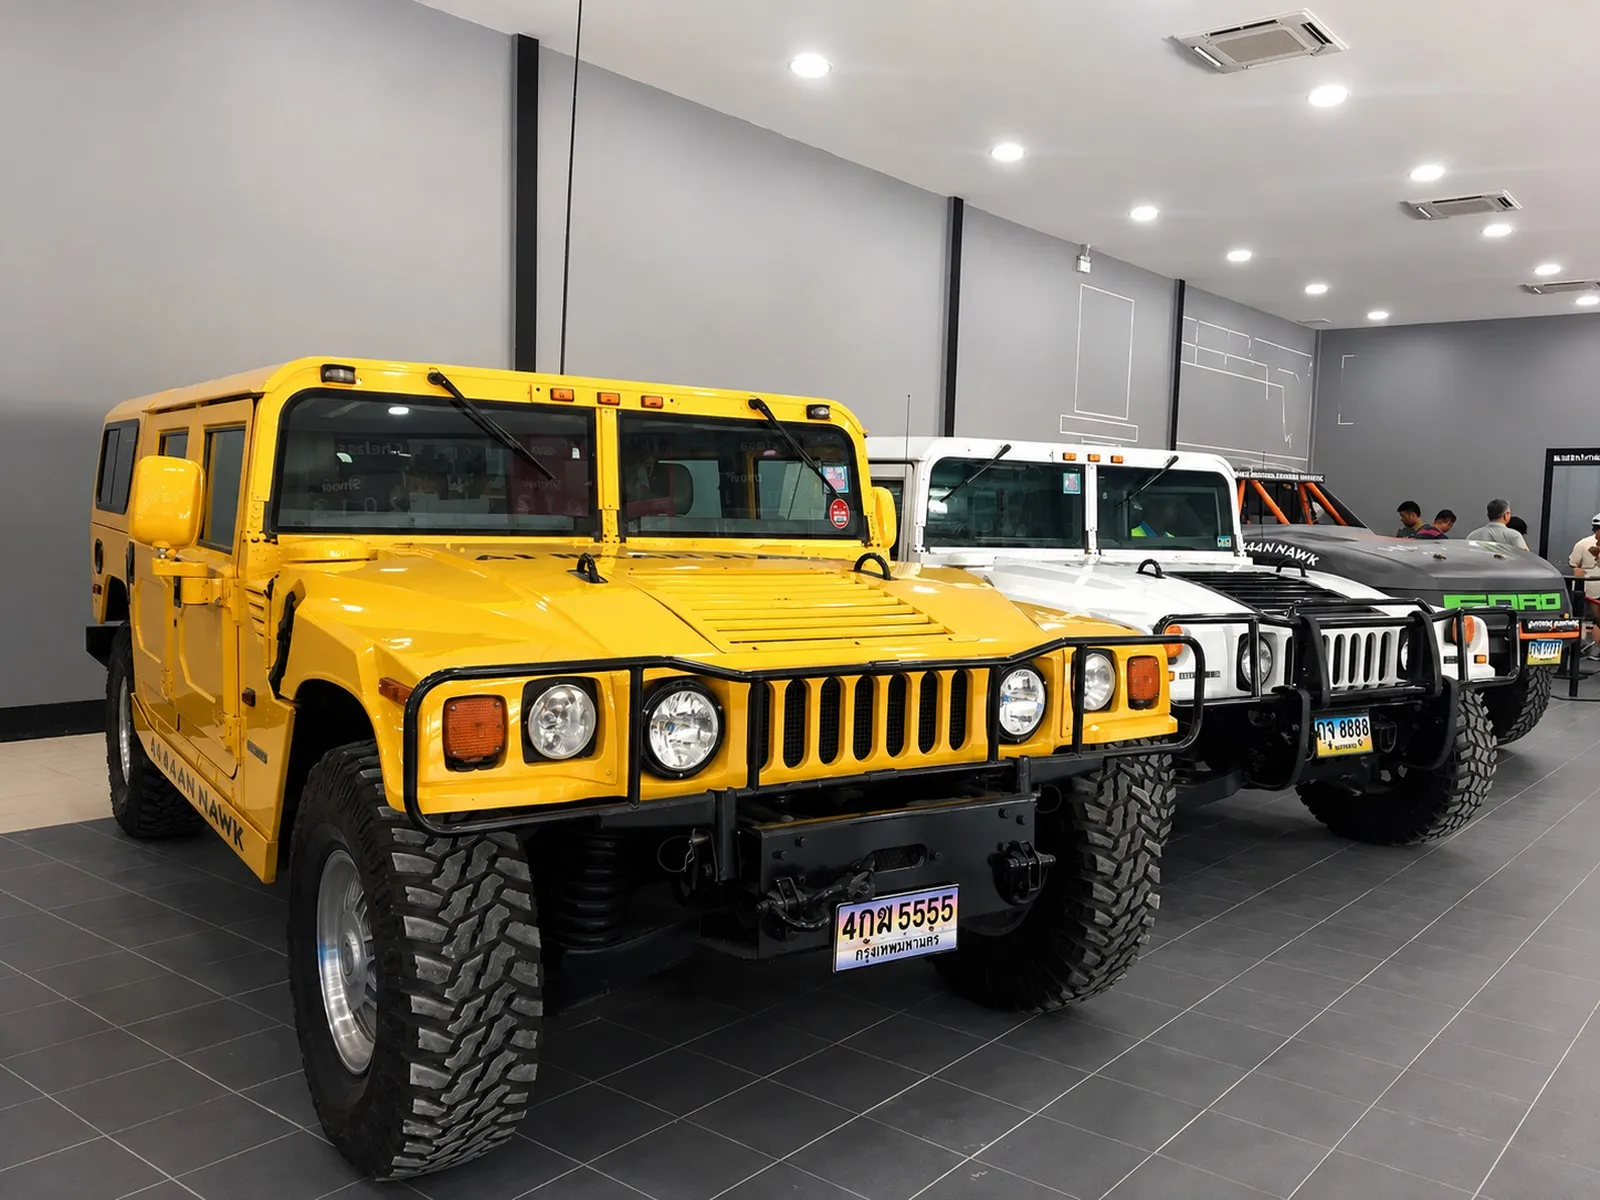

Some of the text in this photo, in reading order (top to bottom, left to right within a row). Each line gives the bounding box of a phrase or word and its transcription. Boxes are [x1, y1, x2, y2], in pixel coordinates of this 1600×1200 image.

[1340, 718, 1369, 739] 8888
[899, 895, 953, 930] 5555
[855, 934, 940, 963] กรุงเทพมหานคร
